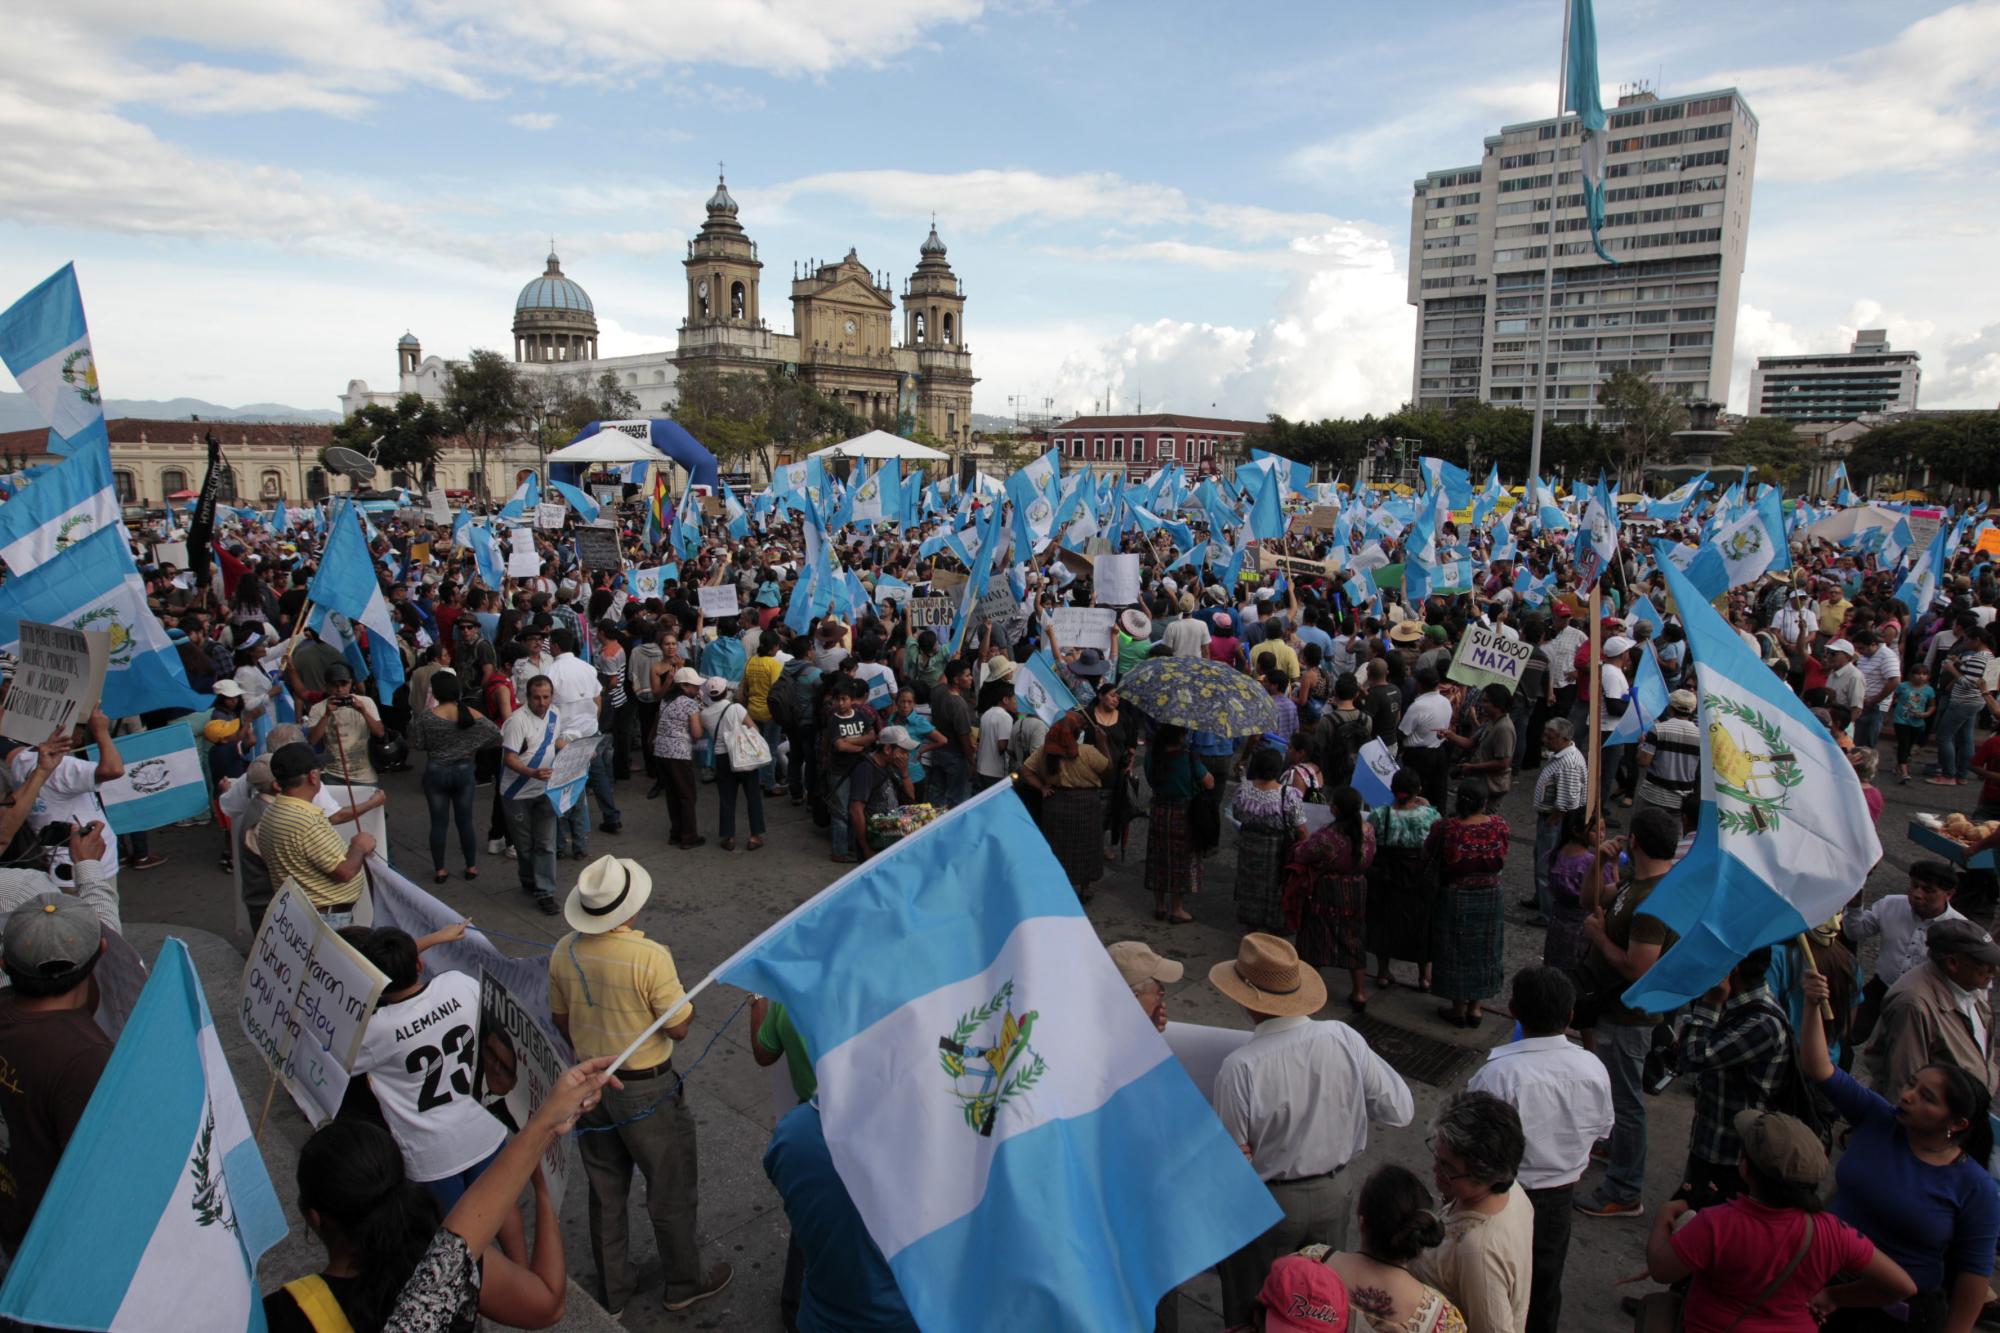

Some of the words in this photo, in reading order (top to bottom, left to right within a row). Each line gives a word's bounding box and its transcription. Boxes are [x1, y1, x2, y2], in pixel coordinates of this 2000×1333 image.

[618, 424, 648, 433] GUATE
[911, 608, 924, 628] MI
[1472, 631, 1492, 647] SU
[1492, 637, 1530, 660] ROBO
[1471, 647, 1516, 677] MATA
[37, 673, 70, 695] DIGNIDAD
[839, 721, 865, 736] GOLF
[273, 891, 345, 1004] Secuestraron
[345, 994, 368, 1023] mi
[259, 927, 293, 994] futuro.
[295, 981, 336, 1052] Estoy
[271, 999, 302, 1039] para
[395, 998, 462, 1042] ALEMANIA
[243, 996, 297, 1081] Rescatarlo
[405, 1024, 475, 1113] 23
[1287, 1294, 1339, 1323] Bulls
